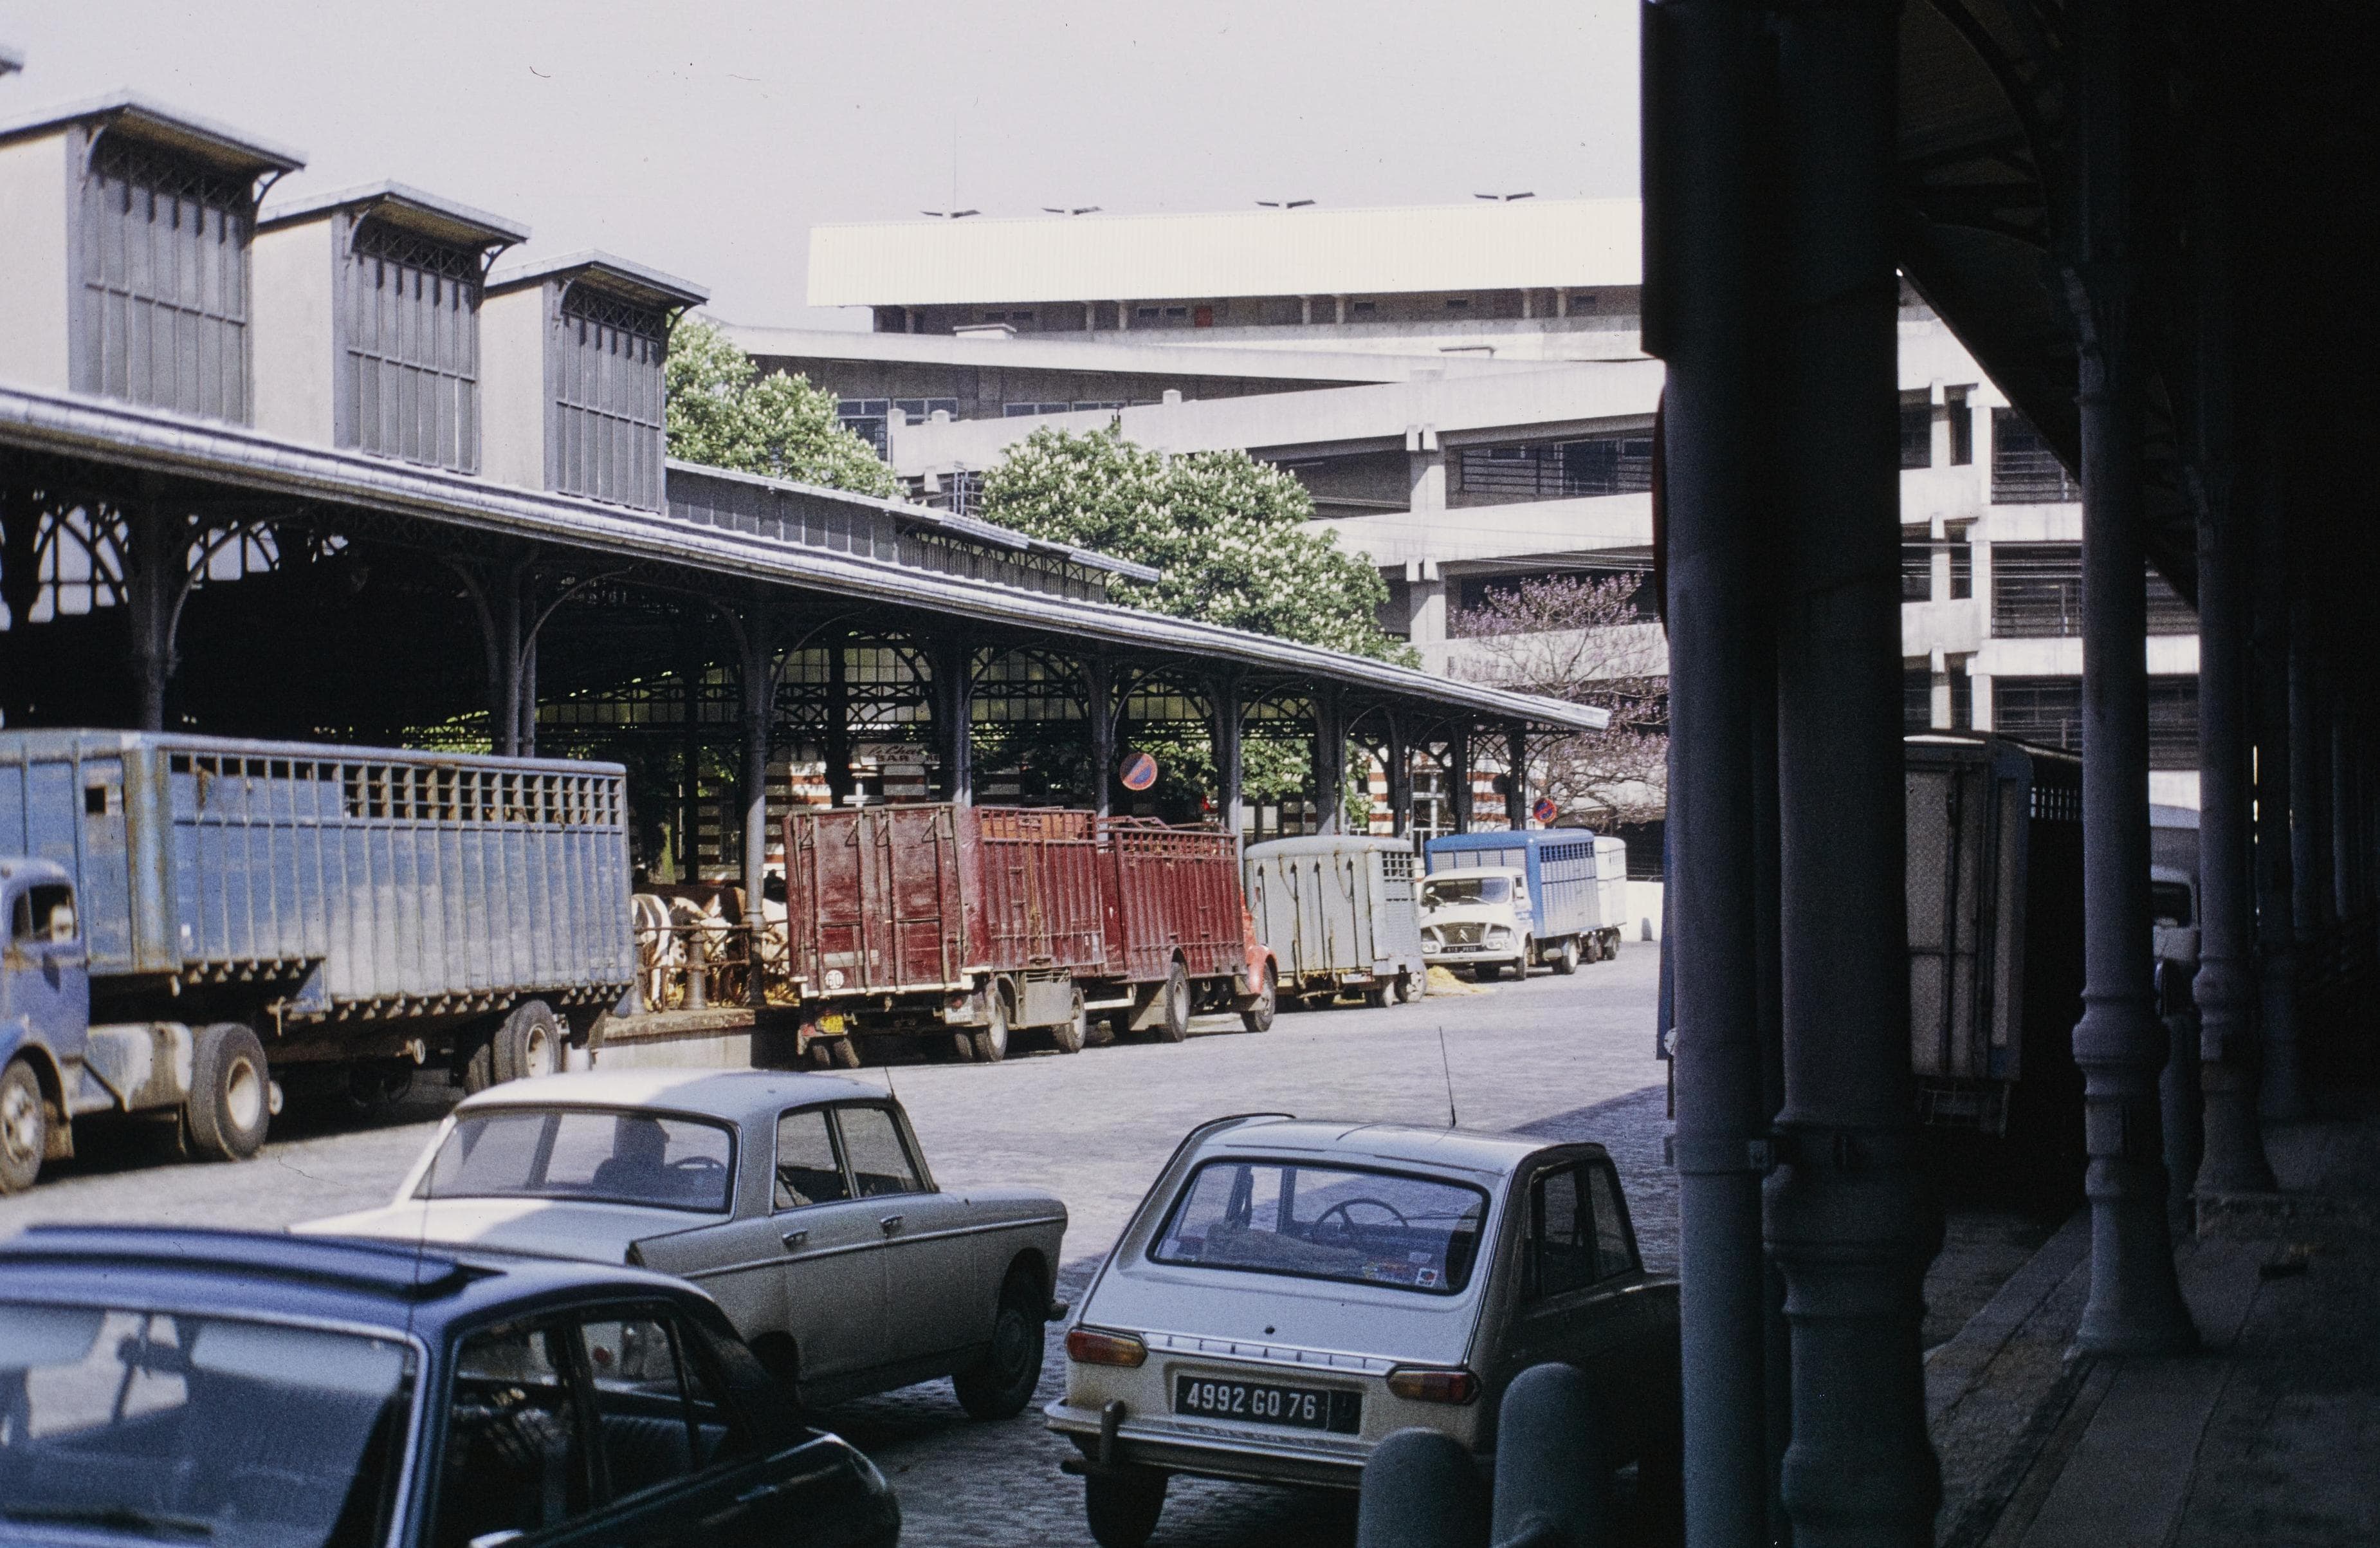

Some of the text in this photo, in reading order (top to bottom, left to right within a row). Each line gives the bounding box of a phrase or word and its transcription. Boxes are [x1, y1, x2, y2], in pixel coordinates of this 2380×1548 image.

[1166, 1334, 1368, 1368] RENAULT
[1187, 1383, 1245, 1413] 4992
[1288, 1393, 1317, 1420] 76
